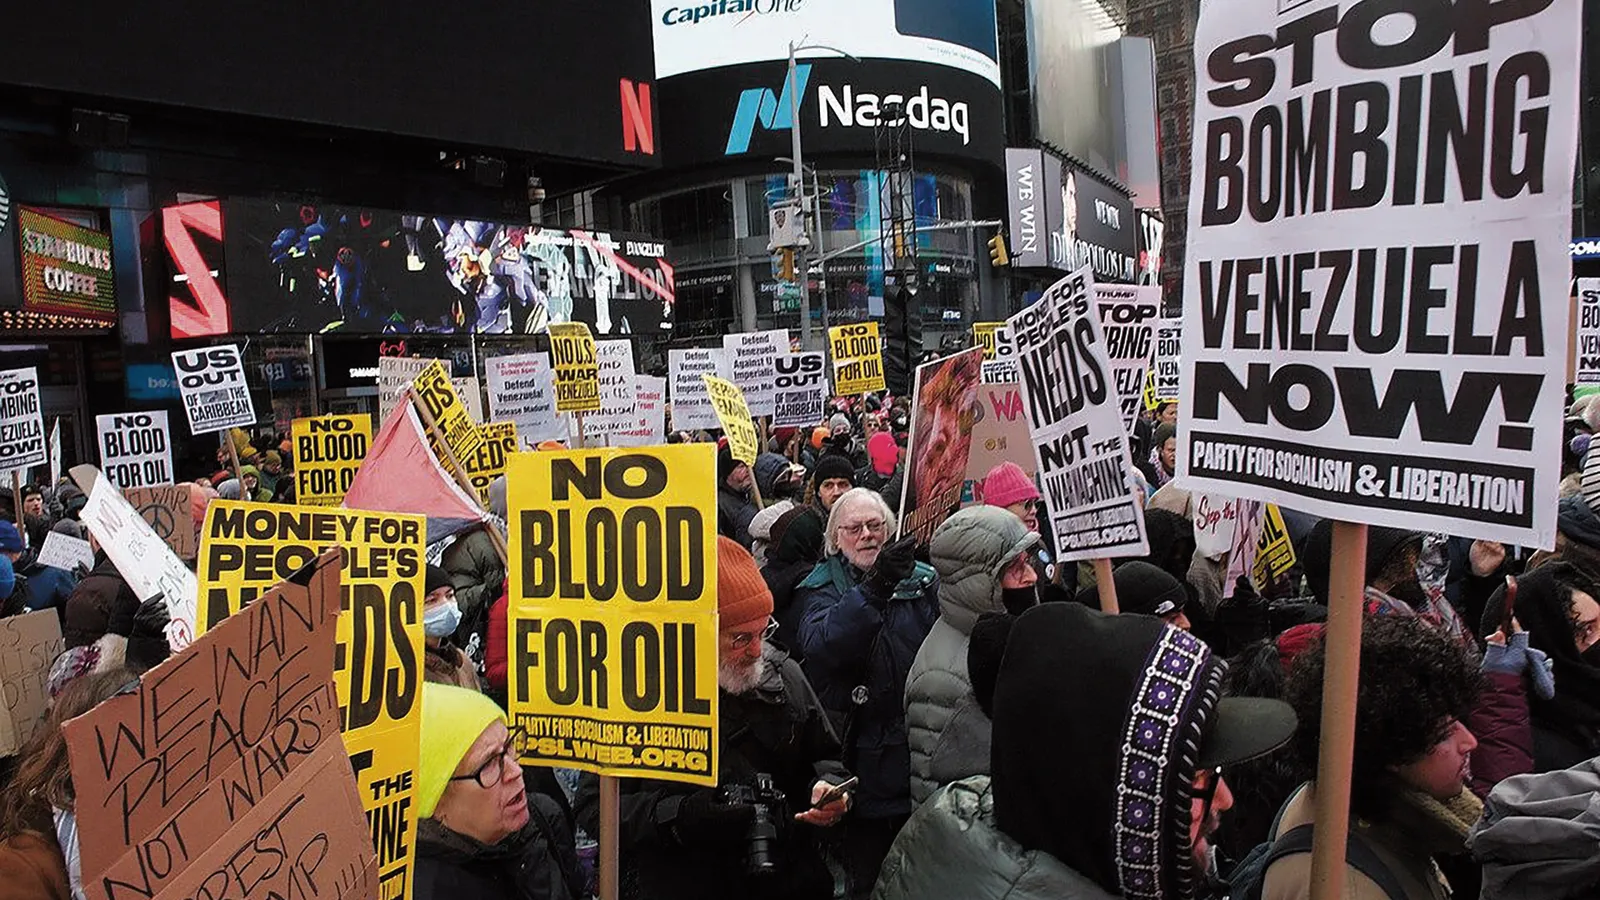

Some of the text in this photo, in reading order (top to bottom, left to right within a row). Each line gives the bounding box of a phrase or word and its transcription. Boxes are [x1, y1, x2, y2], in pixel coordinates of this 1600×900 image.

[1207, 0, 1554, 107] STOP
[817, 85, 970, 146] Nasdaq
[1201, 51, 1551, 227] BOMBING
[24, 228, 111, 271] STARBUCKS
[43, 265, 98, 297] COFFEE
[1051, 275, 1086, 305] FOR
[1199, 240, 1546, 358] VENEZUELA
[840, 325, 868, 337] NO
[176, 349, 238, 373] US
[553, 338, 574, 366] NO
[834, 335, 878, 359] BLOOD
[181, 369, 241, 389] OUT
[555, 368, 598, 382] WAR
[775, 355, 822, 374] US
[837, 359, 882, 382] FOR OIL
[497, 388, 544, 403] Venezuela!
[504, 378, 535, 391] Defend
[775, 373, 822, 388] OUT
[186, 385, 246, 407] OF THE
[774, 393, 785, 404] OF
[808, 389, 822, 401] THE
[775, 402, 822, 418] CARIBBEAN
[1192, 361, 1547, 452] NOW!
[114, 414, 153, 429] NO
[189, 400, 250, 423] CARIBBEAN
[310, 418, 354, 433] NO
[104, 428, 165, 458] BLOOD
[299, 432, 367, 464] BLOOD
[1038, 423, 1122, 474] NOT THE
[106, 459, 173, 489] FOR OIL
[299, 467, 342, 494] FOR
[551, 454, 668, 501] NO
[1193, 440, 1526, 516] PARTY FOR SOCIALISM & LIBERATION
[211, 508, 419, 545] MONEY FOR
[519, 506, 705, 602] BLOOD
[95, 651, 210, 780] WE
[212, 553, 341, 704] WANT
[514, 617, 712, 716] FOR OIL
[104, 645, 310, 846] PEACE
[517, 714, 709, 751] PARTY FOR SOCIALISM & LIBERATION
[370, 769, 413, 801] THE
[103, 788, 210, 899] NOT
